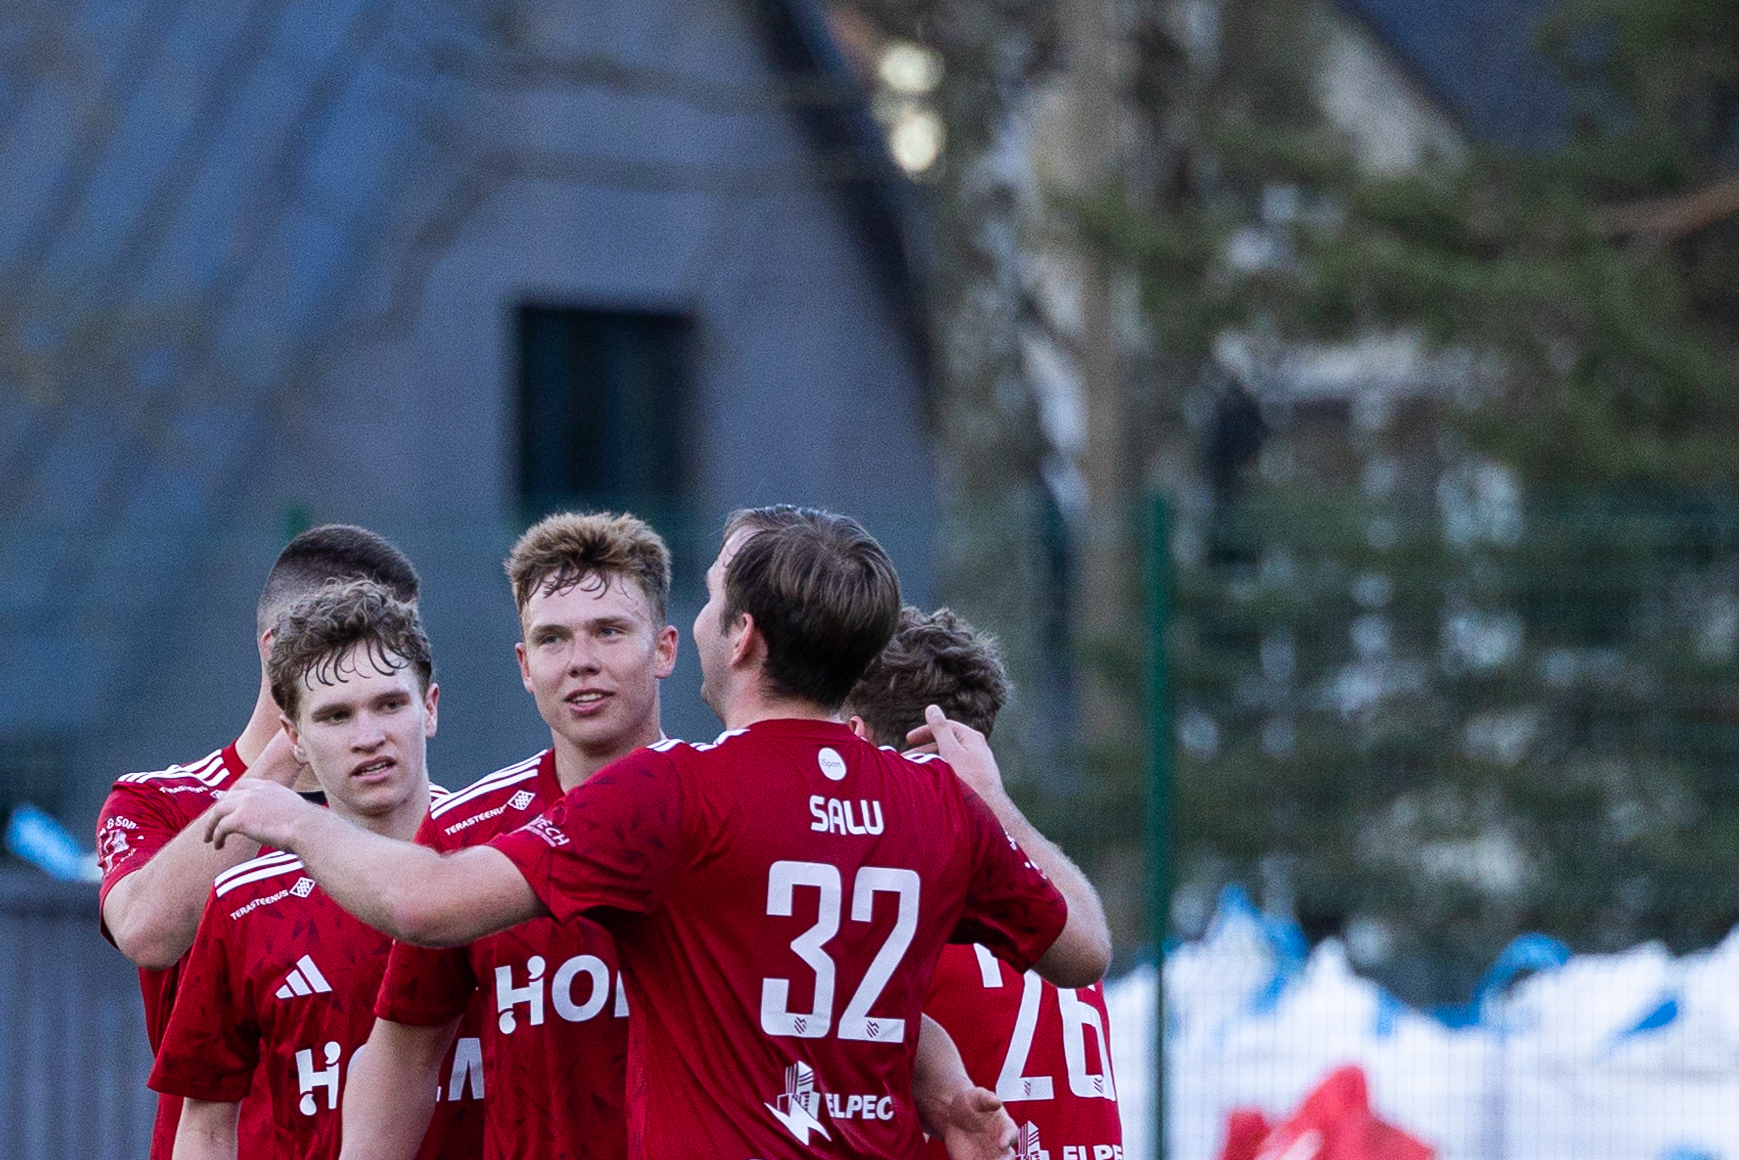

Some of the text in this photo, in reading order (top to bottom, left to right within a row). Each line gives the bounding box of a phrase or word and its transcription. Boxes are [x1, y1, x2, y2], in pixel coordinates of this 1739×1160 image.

[444, 803, 508, 836] TERASTEENU
[809, 795, 884, 835] SALU
[230, 889, 289, 920] TERASTEENUS
[760, 860, 920, 1043] 32
[825, 1093, 894, 1120] ELPEC
